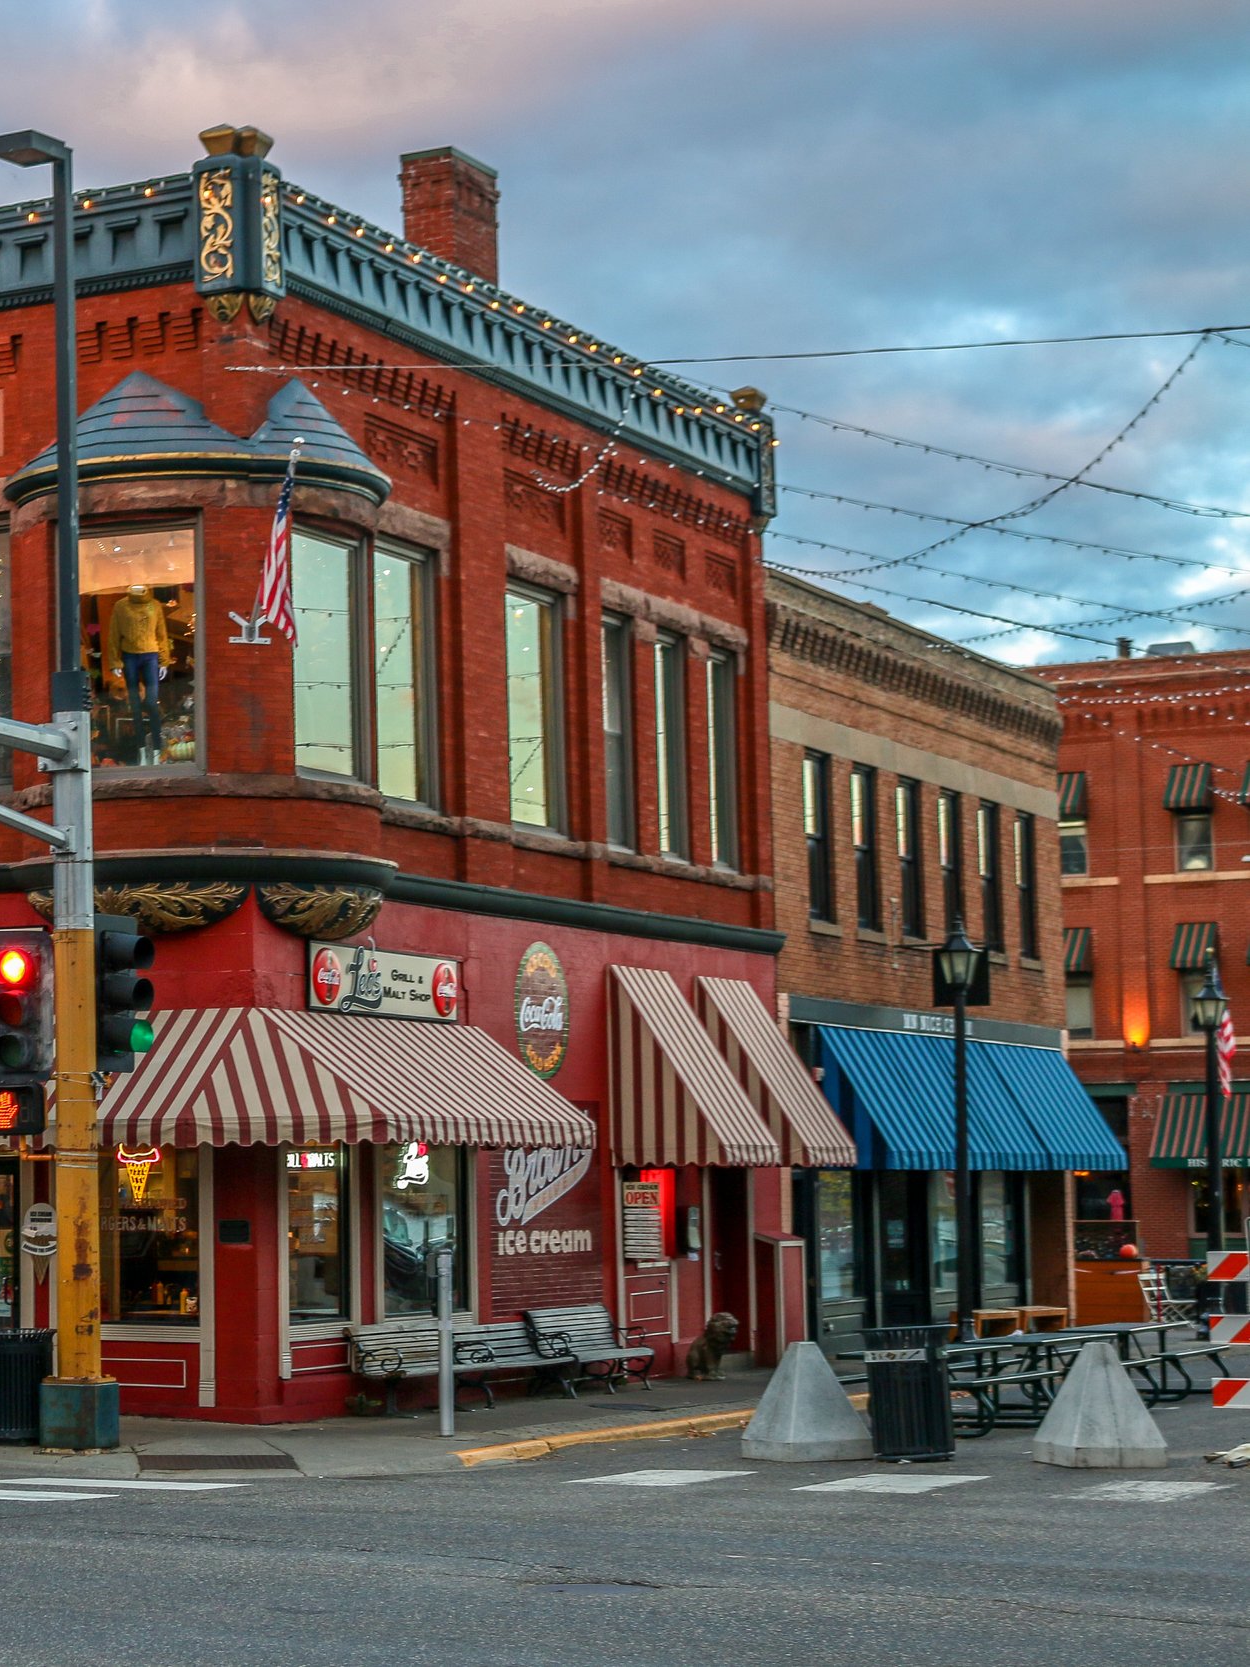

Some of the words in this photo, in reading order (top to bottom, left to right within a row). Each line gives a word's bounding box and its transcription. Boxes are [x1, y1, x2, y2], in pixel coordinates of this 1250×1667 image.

[390, 969, 416, 984] GRILL
[382, 986, 407, 1000] MALT
[409, 989, 432, 1002] SHOP
[625, 1192, 659, 1205] OPEN
[498, 1230, 527, 1255] ice
[530, 1230, 592, 1254] cream
